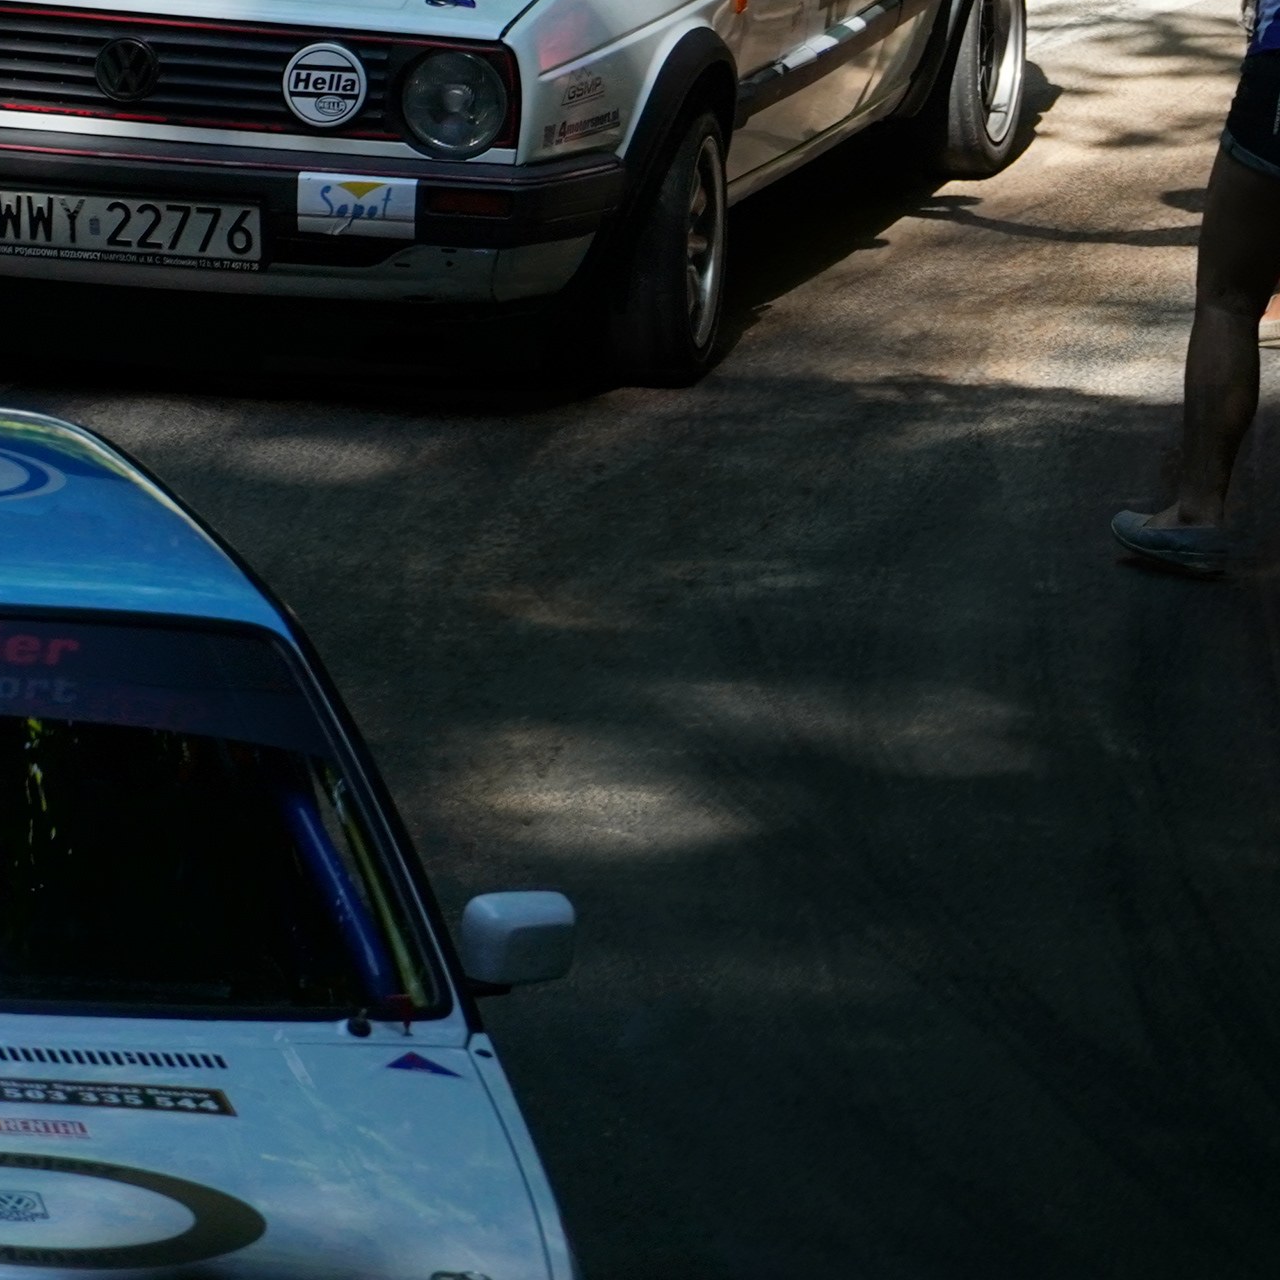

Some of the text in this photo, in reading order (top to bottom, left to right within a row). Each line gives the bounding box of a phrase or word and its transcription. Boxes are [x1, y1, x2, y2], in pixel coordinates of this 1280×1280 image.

[293, 71, 356, 93] Hella
[567, 76, 602, 101] GSMP
[106, 200, 254, 255] 22776
[14, 246, 59, 258] POJAZDOWA
[3, 1087, 220, 1111] 503 335 544
